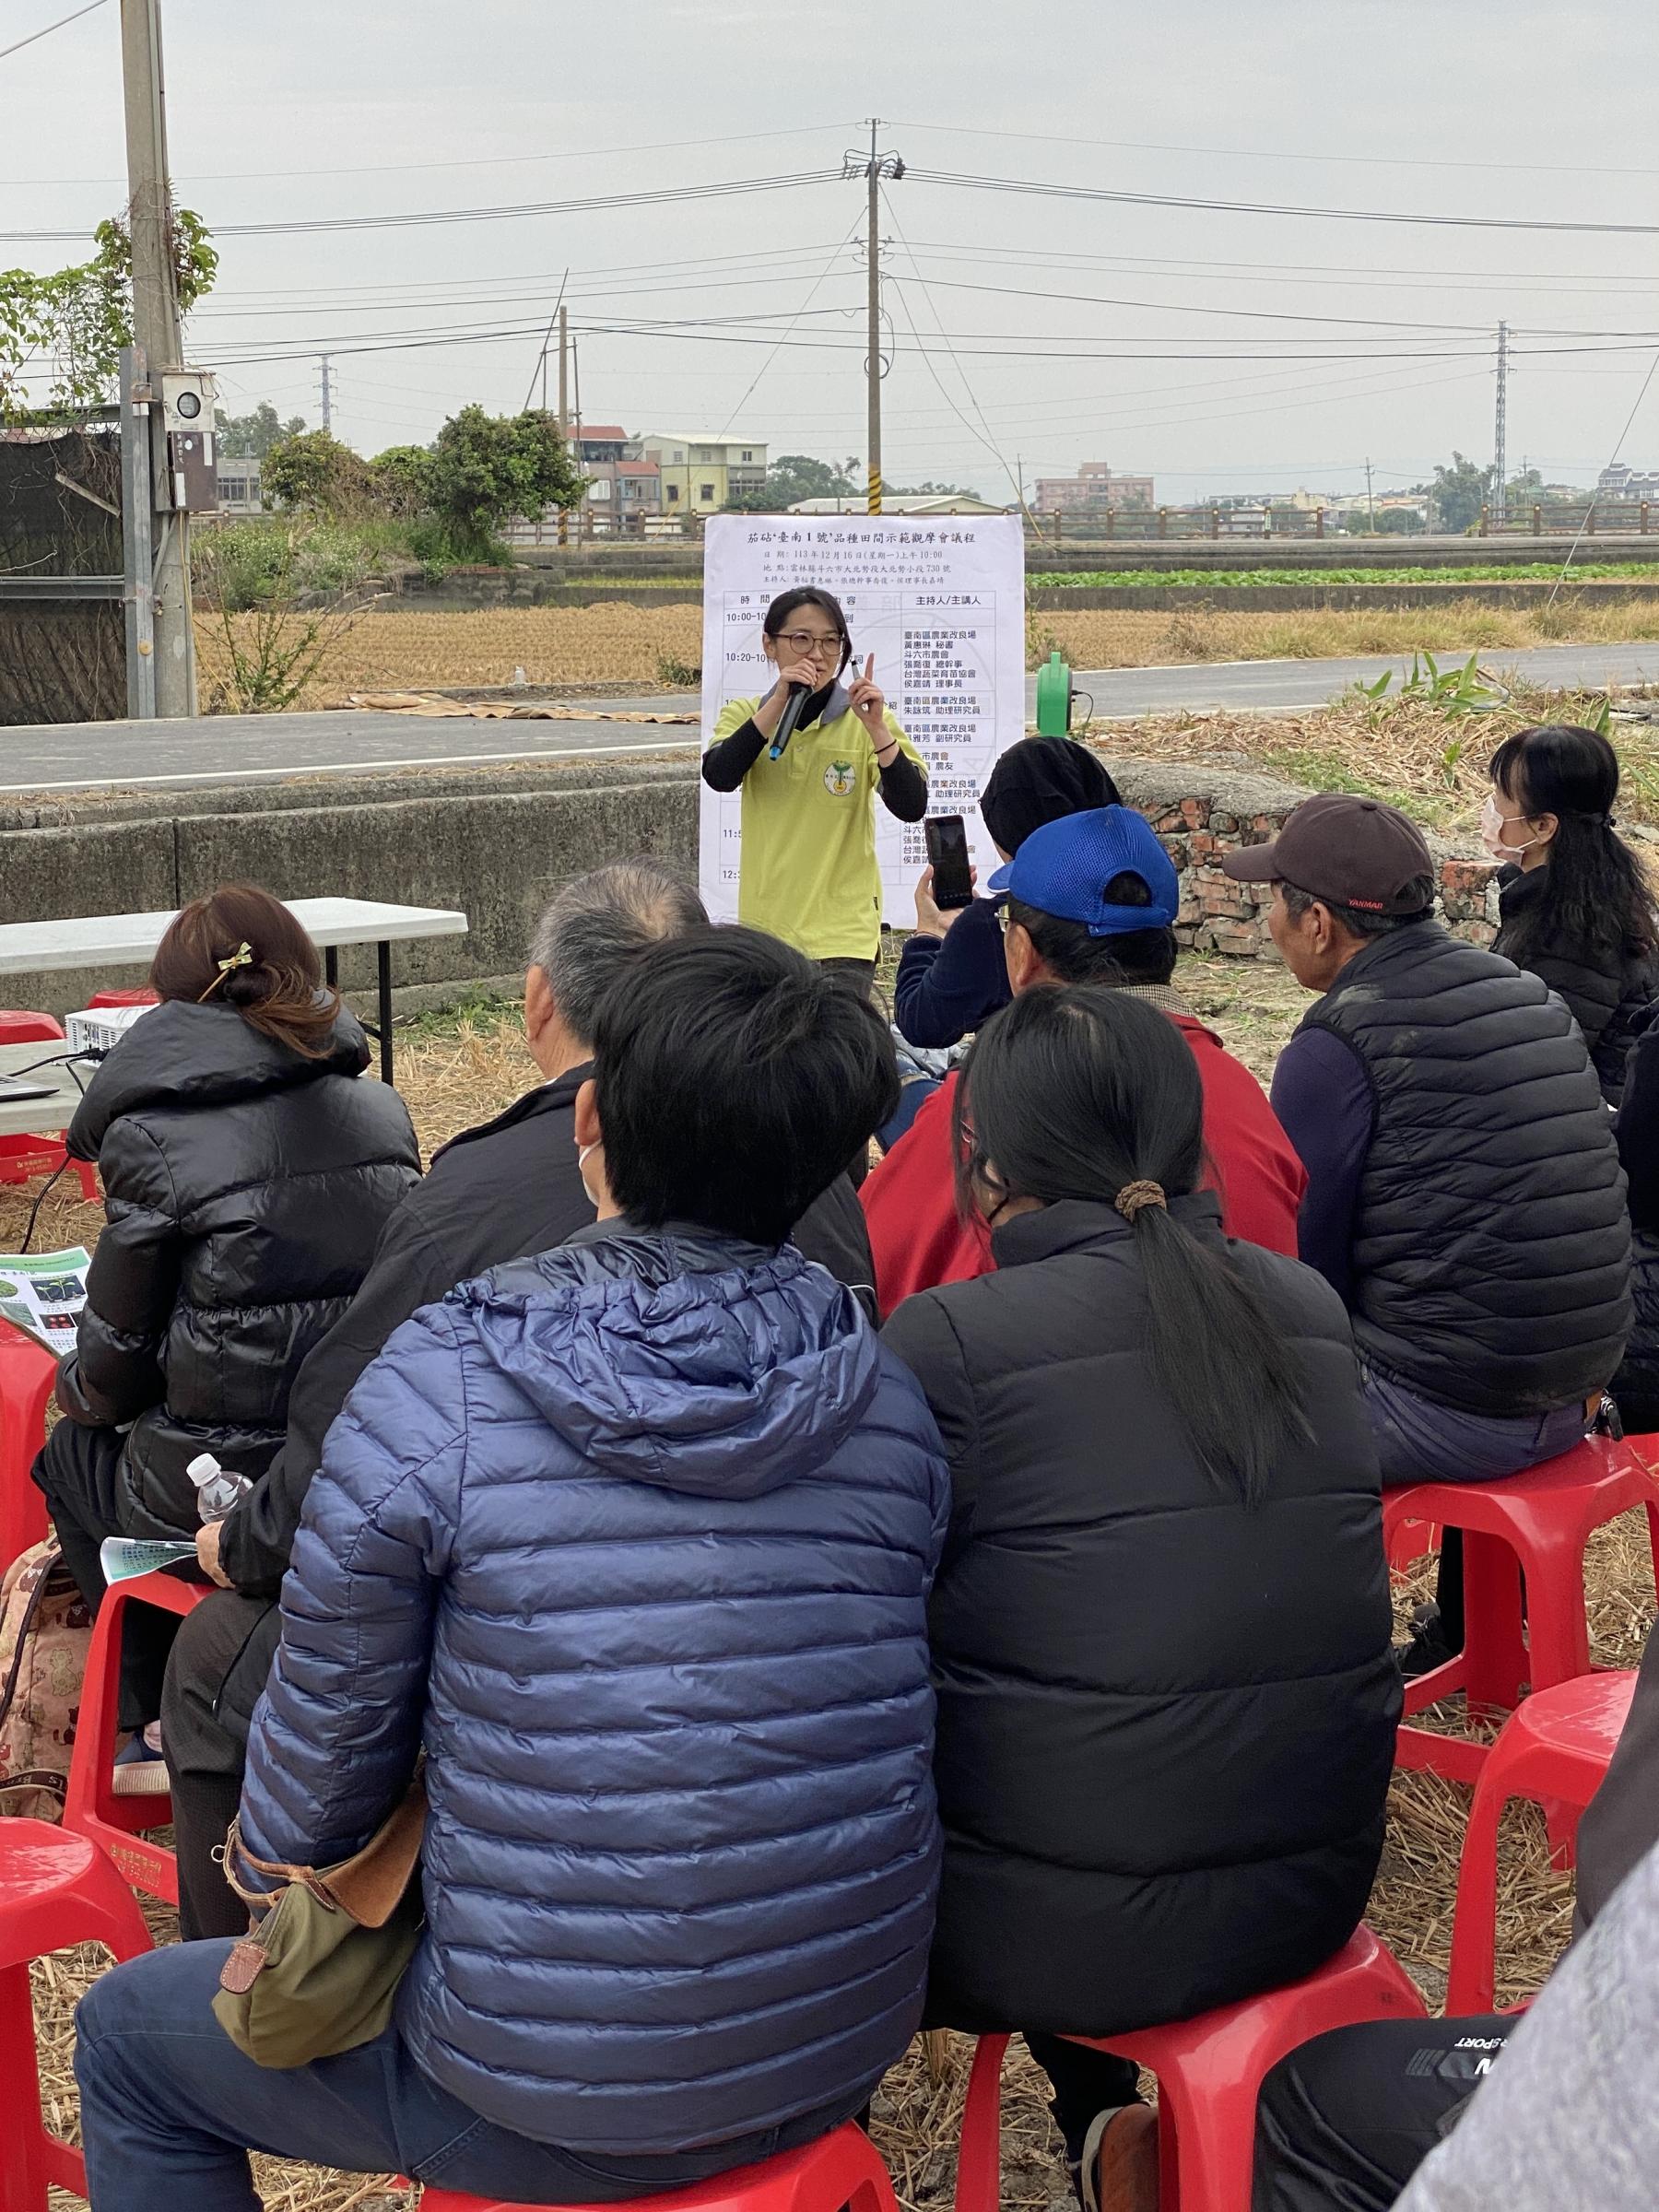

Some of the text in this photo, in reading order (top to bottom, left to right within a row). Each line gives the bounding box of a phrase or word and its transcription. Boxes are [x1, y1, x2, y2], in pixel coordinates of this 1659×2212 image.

[915, 595, 982, 606] 主持人/主講人
[904, 630, 977, 640] 臺南區農業改良場
[904, 650, 949, 659] 斗六市農會
[935, 660, 963, 669] 總幹事
[904, 669, 977, 678] 台灣蔬菜育苗協會
[935, 679, 963, 688] 理事長
[904, 696, 977, 705] 臺南區農業改良場
[935, 706, 981, 715] 助理研究員
[904, 724, 977, 733] 臺南區農業改良場
[935, 734, 971, 743] 副研究員
[921, 751, 949, 760] 市農會
[926, 780, 977, 789] 農業改良場
[935, 789, 981, 798] 助理研究員
[925, 806, 977, 815] 農業改良場
[903, 825, 925, 834] 斗六
[1348, 899, 1383, 910] YANMAR
